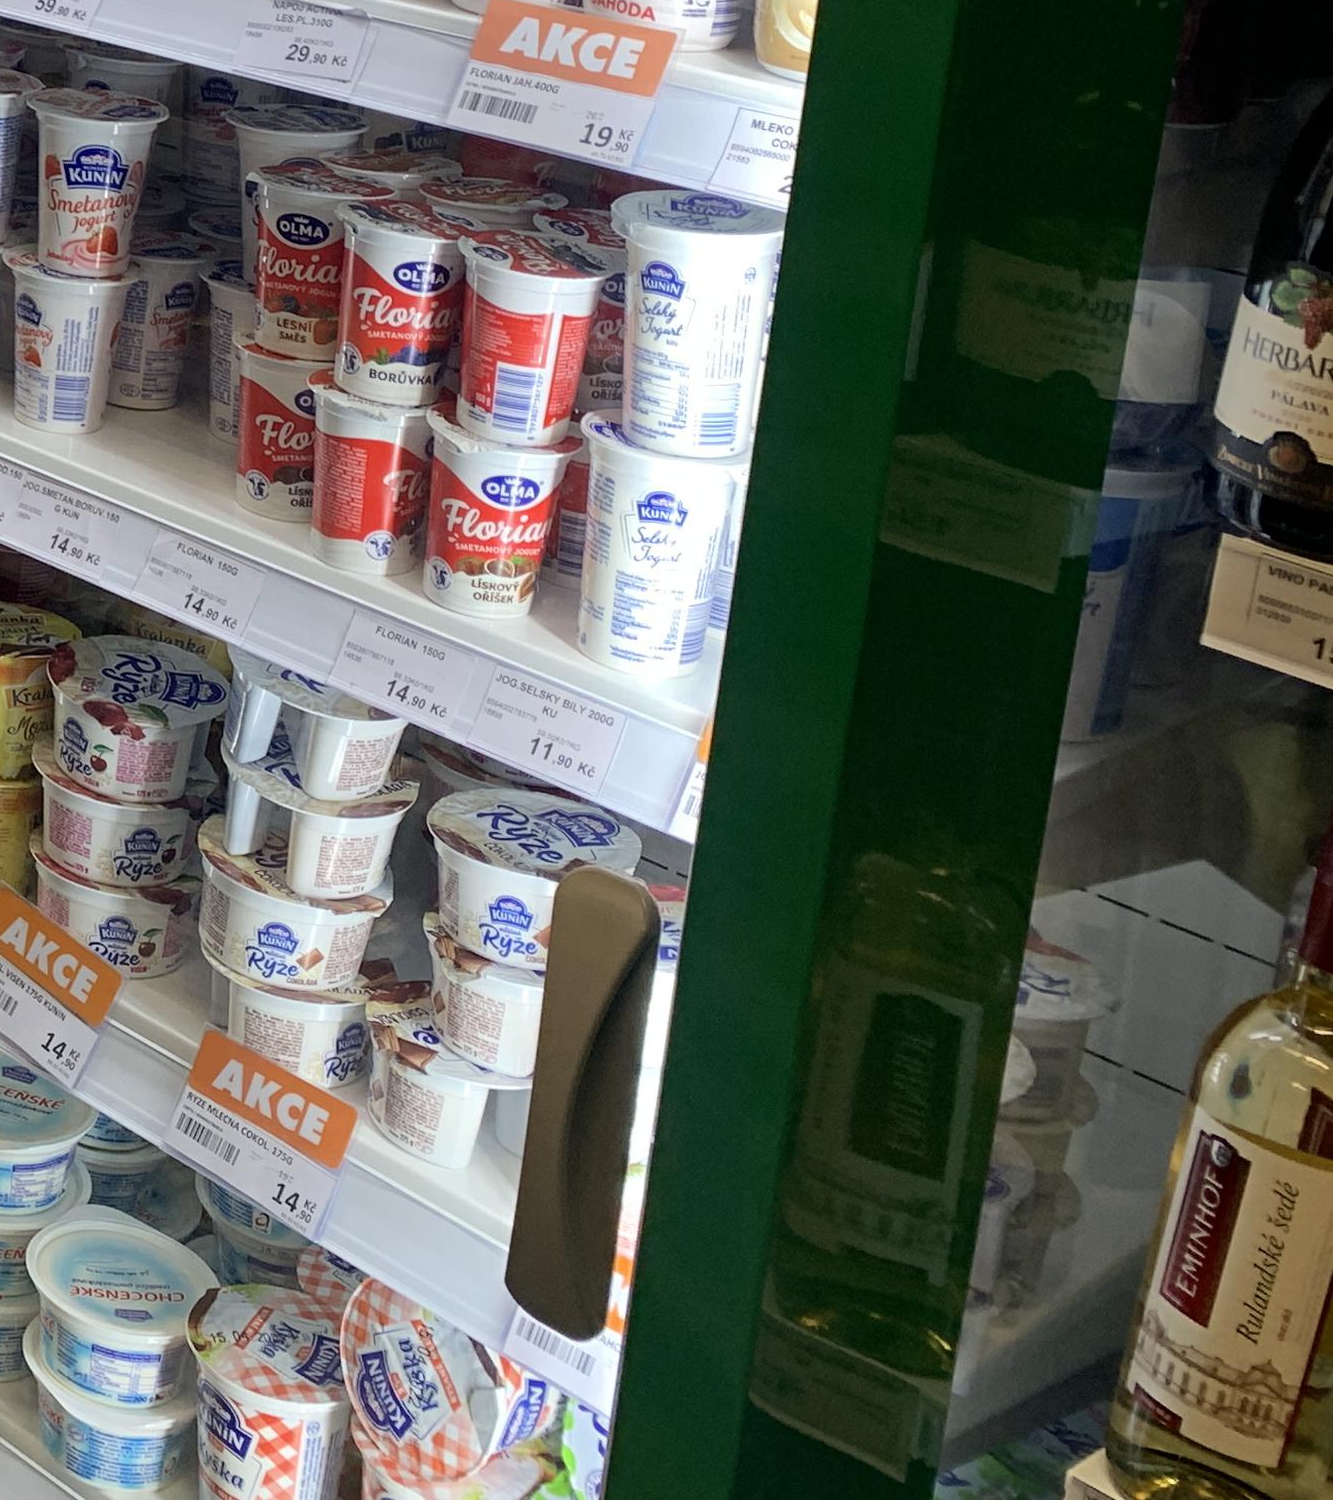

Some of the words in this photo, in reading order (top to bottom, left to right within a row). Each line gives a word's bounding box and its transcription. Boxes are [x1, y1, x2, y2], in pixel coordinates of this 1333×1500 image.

[73, 7, 88, 21] Kč
[276, 12, 333, 28] LES.PL.310G
[285, 43, 328, 66] 29,90
[331, 54, 349, 67] Kč
[499, 16, 646, 80] AKCE
[470, 68, 512, 85] FLORIAN
[512, 76, 561, 96] JAH.400G
[618, 128, 634, 142] Kč
[751, 118, 794, 135] MLEKO
[279, 221, 327, 241] OLMA
[397, 267, 447, 285] OLMA
[276, 315, 313, 332] LESNÍ
[278, 331, 308, 345] SMĚS
[368, 366, 433, 387] BORŮVKA
[487, 481, 538, 500] OLMA
[63, 507, 81, 521] KUN
[50, 533, 83, 561] 14,90
[86, 554, 101, 567] Kč
[177, 542, 214, 567] FLORIAN
[217, 562, 239, 578] 150G
[471, 577, 520, 594] LÍSKOVÝ
[1269, 565, 1304, 586] VINO
[473, 590, 514, 604] OŘÍŠEK
[184, 592, 219, 621] 14,90
[222, 615, 238, 630] Kč
[375, 625, 418, 651] FLORIAN
[421, 643, 446, 662] 150G
[386, 680, 427, 710] 14,90
[430, 703, 448, 719] Kč
[495, 672, 560, 705] JOG.SELSKY
[561, 695, 588, 715] BILY
[588, 708, 615, 727] 200G
[542, 706, 559, 720] KU
[529, 736, 573, 770] 11,90
[578, 761, 596, 779] Kč
[113, 855, 163, 881] Rýže
[480, 923, 539, 958] Rýže
[246, 945, 300, 979] Rýže
[4, 965, 26, 990] VISEN
[26, 984, 45, 1004] 175G
[43, 999, 67, 1022] KUNIN
[68, 1047, 82, 1062] Kč
[214, 1058, 324, 1147] AKCE
[187, 1091, 207, 1109] RYZE
[206, 1103, 241, 1128] MLECNA
[240, 1125, 271, 1152] COKOL.
[271, 1145, 294, 1167] 175G
[303, 1199, 317, 1214] Kč
[1175, 1164, 1222, 1298] EMINHOF
[1236, 1234, 1283, 1347] Rulandské
[1263, 1180, 1300, 1236] šedé
